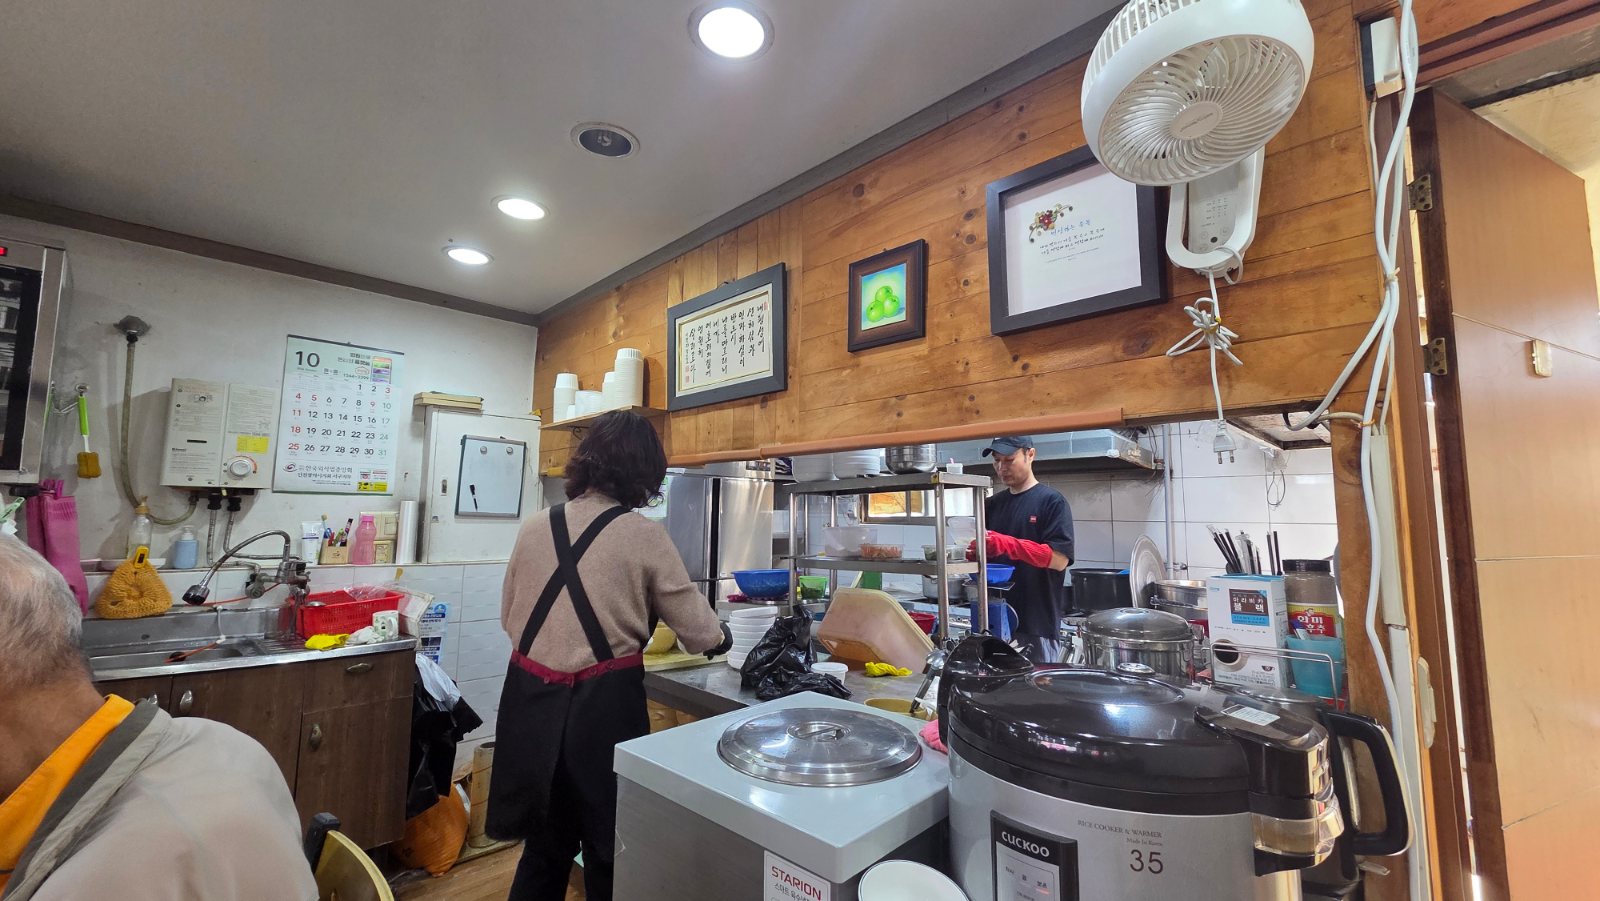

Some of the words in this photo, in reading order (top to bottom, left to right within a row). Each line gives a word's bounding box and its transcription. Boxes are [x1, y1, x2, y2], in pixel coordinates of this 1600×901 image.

[296, 351, 320, 368] 10
[1078, 820, 1092, 829] RICE
[1094, 823, 1123, 834] COOKER
[1132, 829, 1162, 838] WARMER
[1001, 831, 1050, 858] CUCKOO
[1130, 849, 1163, 874] 35
[772, 866, 821, 901] STARION
